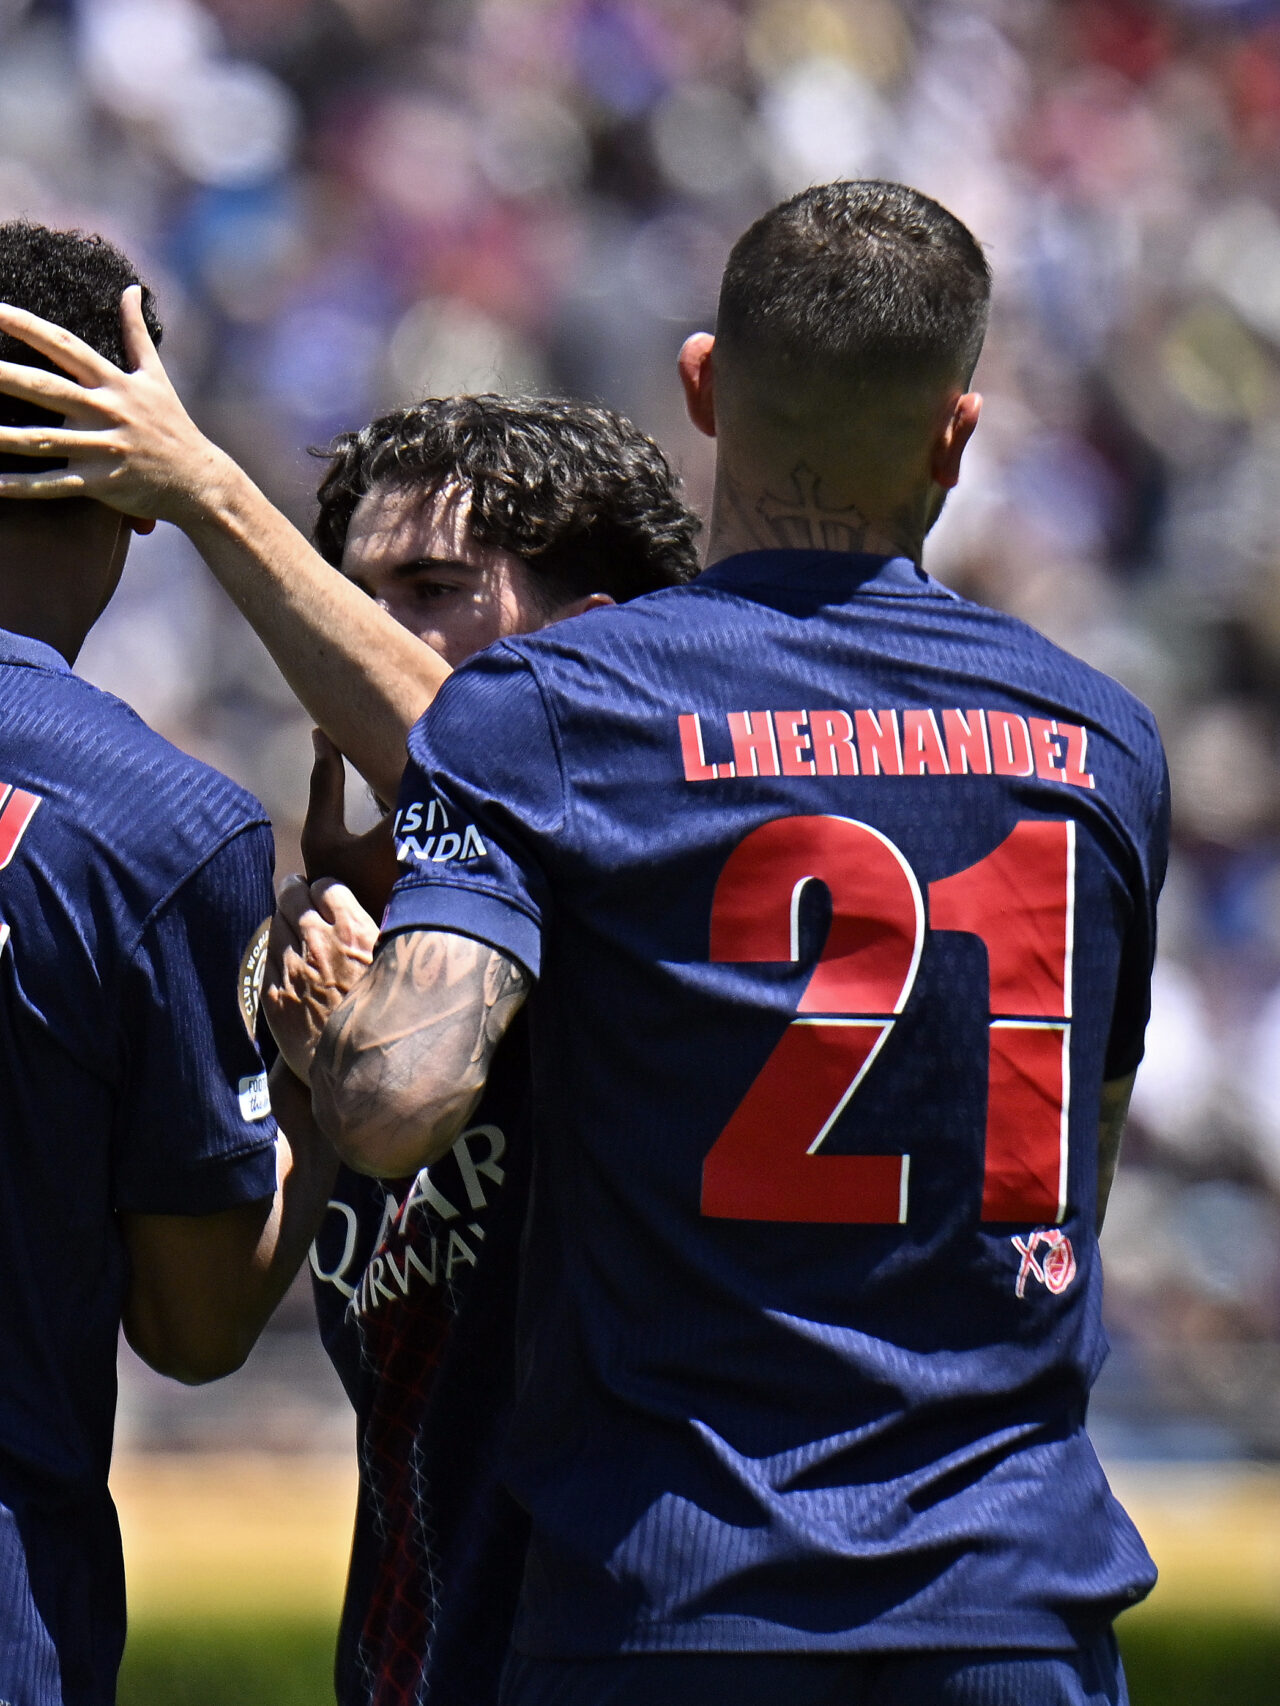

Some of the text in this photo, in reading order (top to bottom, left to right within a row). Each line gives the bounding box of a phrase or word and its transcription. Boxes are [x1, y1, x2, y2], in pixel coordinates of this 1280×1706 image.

[678, 708, 1097, 789] L.HERNANDEZ
[243, 975, 254, 1016] CLUB
[700, 814, 1076, 1225] 21
